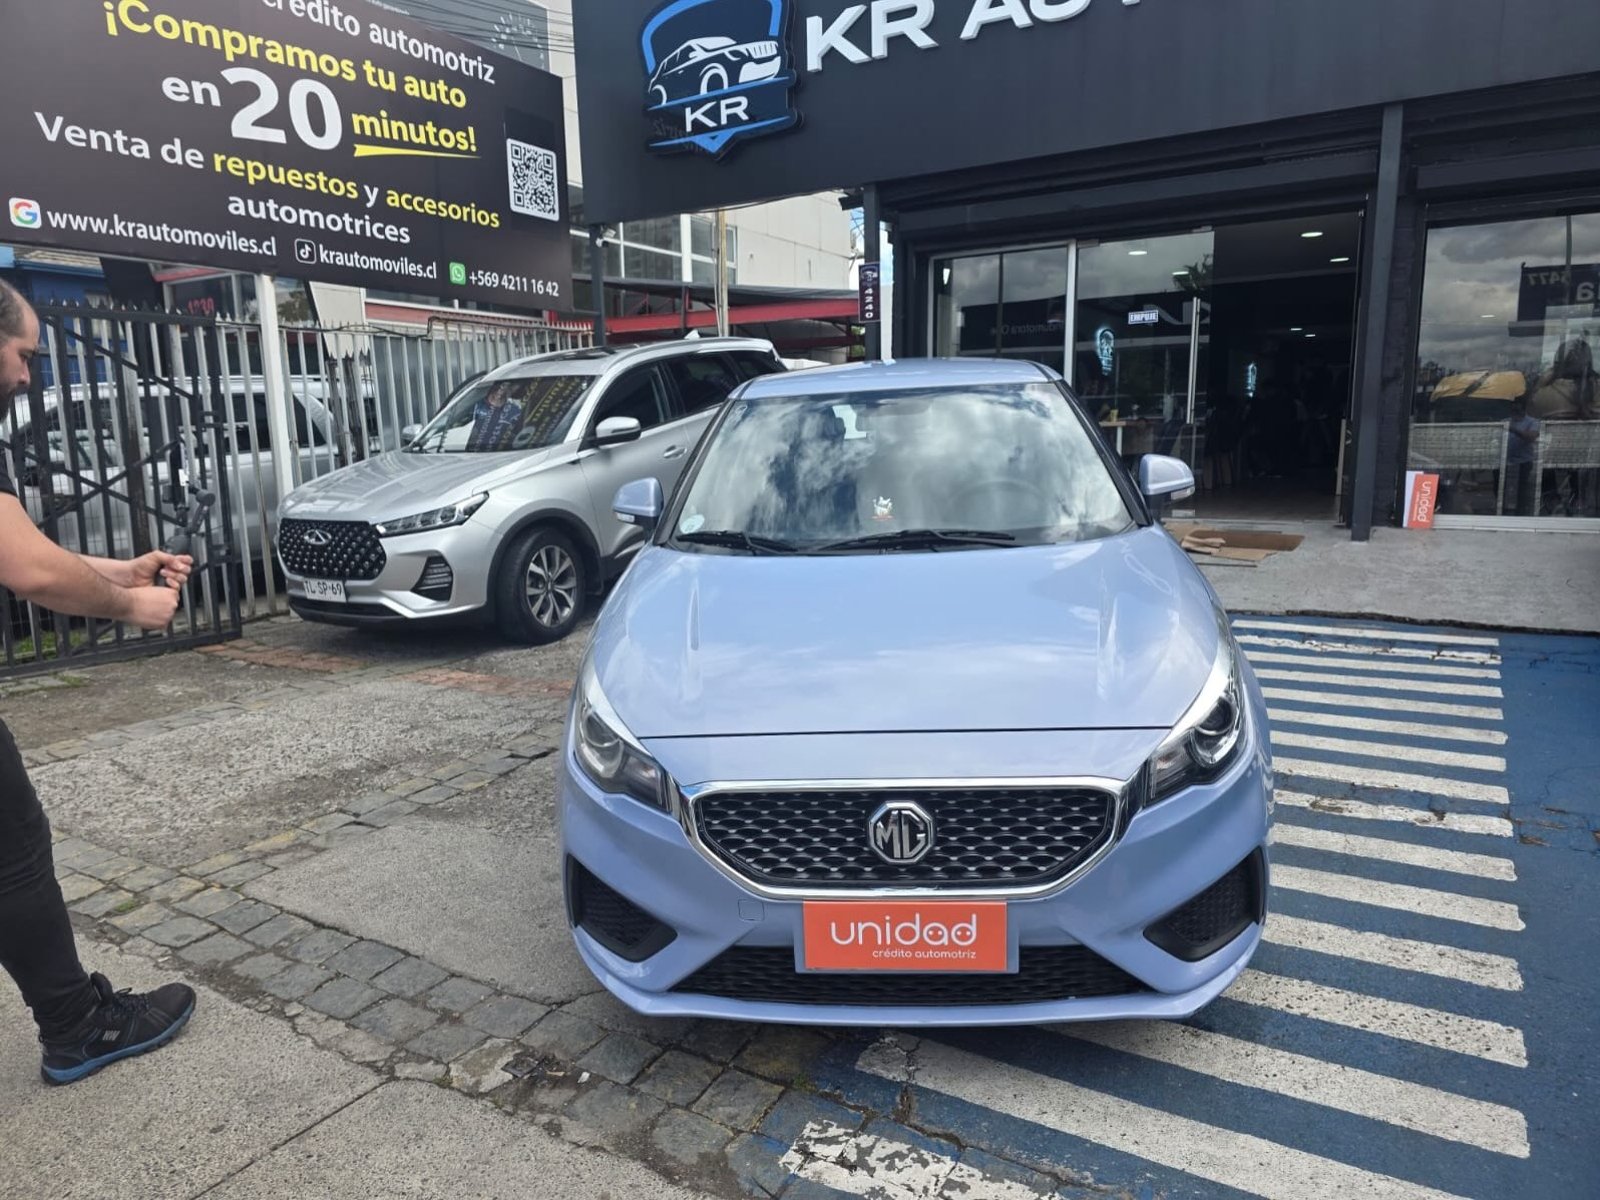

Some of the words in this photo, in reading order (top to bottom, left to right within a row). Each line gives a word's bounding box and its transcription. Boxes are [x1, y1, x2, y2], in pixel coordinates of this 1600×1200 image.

[102, 0, 357, 81] ¡Compramos
[363, 59, 397, 92] tu
[403, 75, 468, 108] auto
[368, 22, 496, 84] automotriz
[805, 0, 940, 73] KR
[161, 76, 222, 107] en
[220, 66, 342, 150] 20
[351, 109, 477, 152] minutos!
[684, 95, 750, 133] KR
[33, 111, 151, 160] Venta
[160, 137, 205, 169] de
[213, 153, 359, 200] repuestos
[363, 184, 380, 208] y
[386, 189, 500, 228] accesorios
[47, 209, 278, 256] www.krautomoviles.cl
[227, 196, 411, 244] automotrices
[319, 244, 437, 280] krautomoviles.cl
[469, 269, 500, 288] +569
[501, 275, 528, 293] 4211
[531, 278, 544, 295] 16
[545, 281, 560, 298] 42
[864, 287, 874, 319] 4240
[875, 810, 926, 858] MG
[830, 912, 977, 946] unidad
[872, 948, 912, 959] crédito
[914, 949, 977, 960] automotriz
